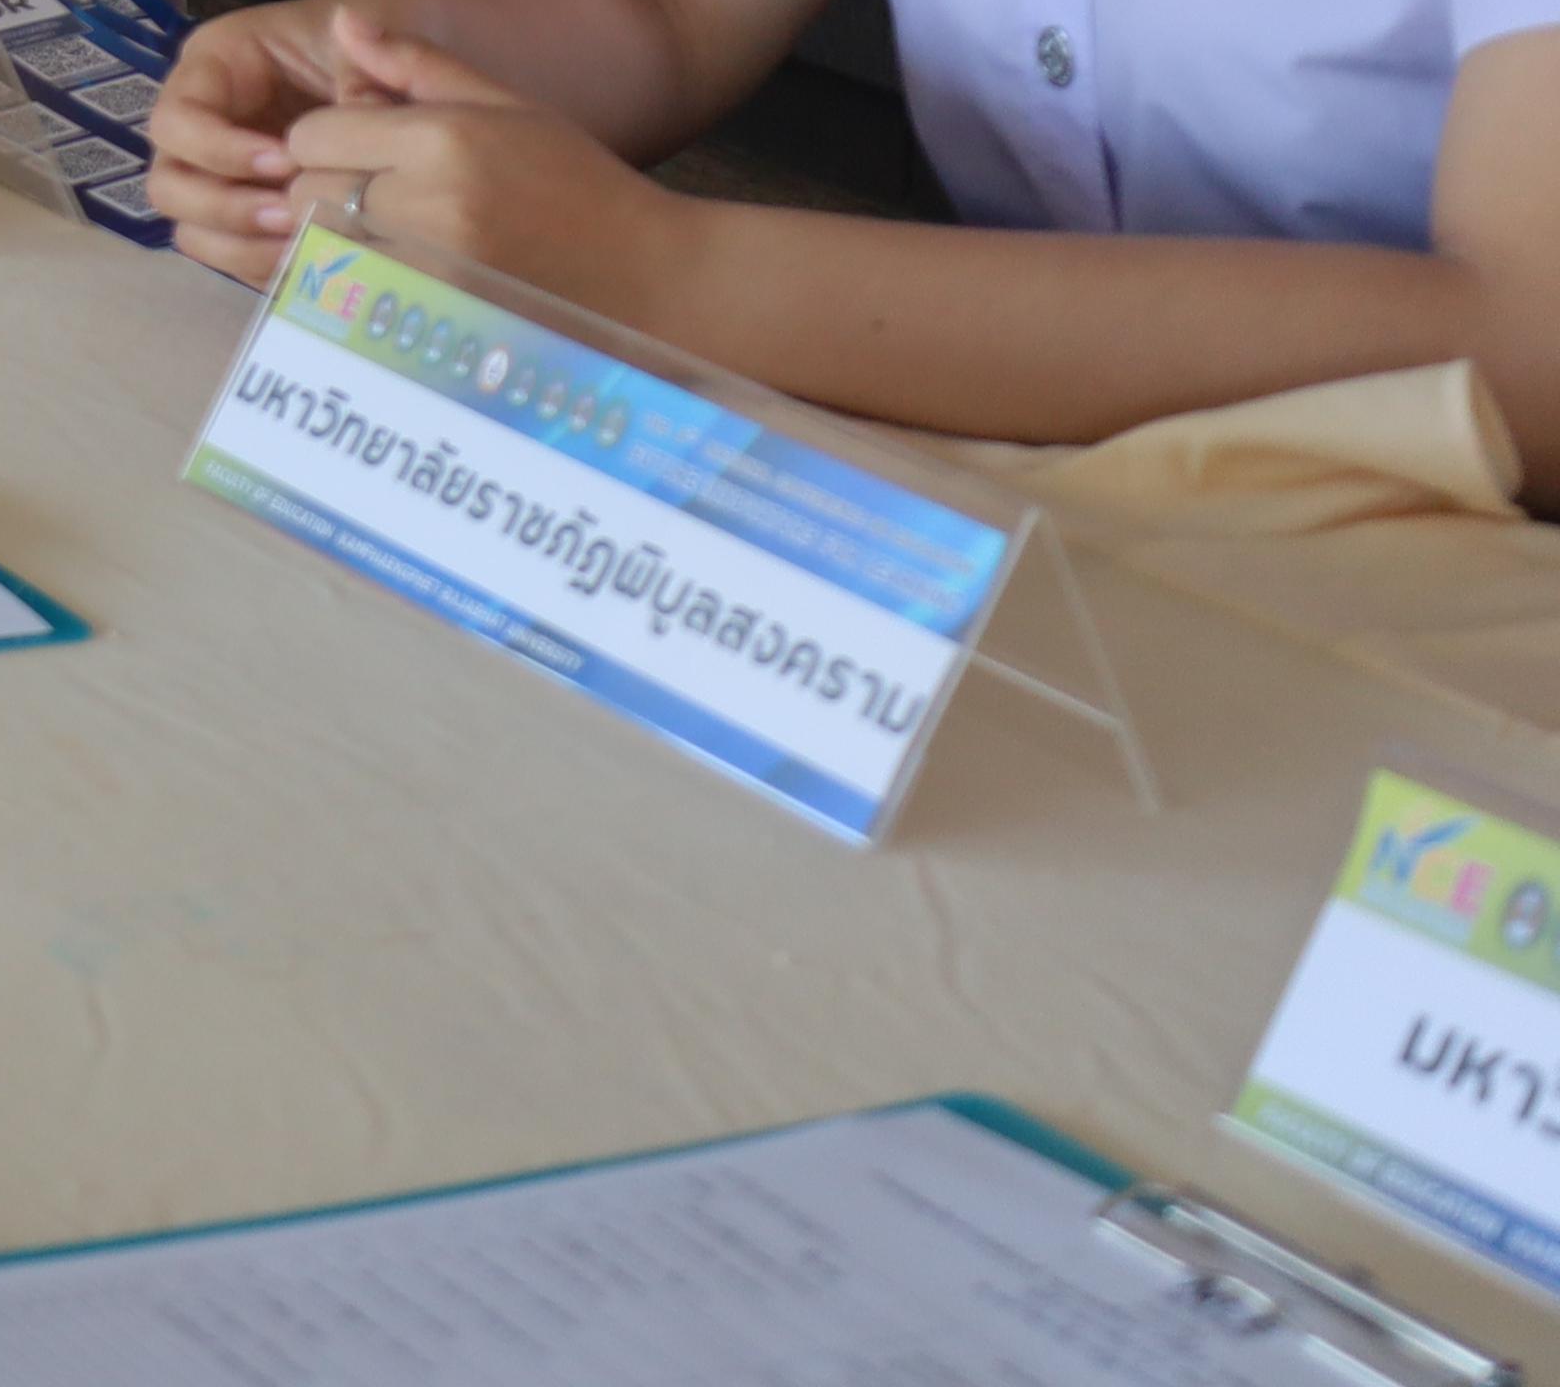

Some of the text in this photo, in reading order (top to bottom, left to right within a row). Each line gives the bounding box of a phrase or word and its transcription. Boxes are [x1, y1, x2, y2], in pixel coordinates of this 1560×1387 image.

[235, 362, 925, 737] มหาวิทยาลัยราชภัฏพิบูลสงคราม
